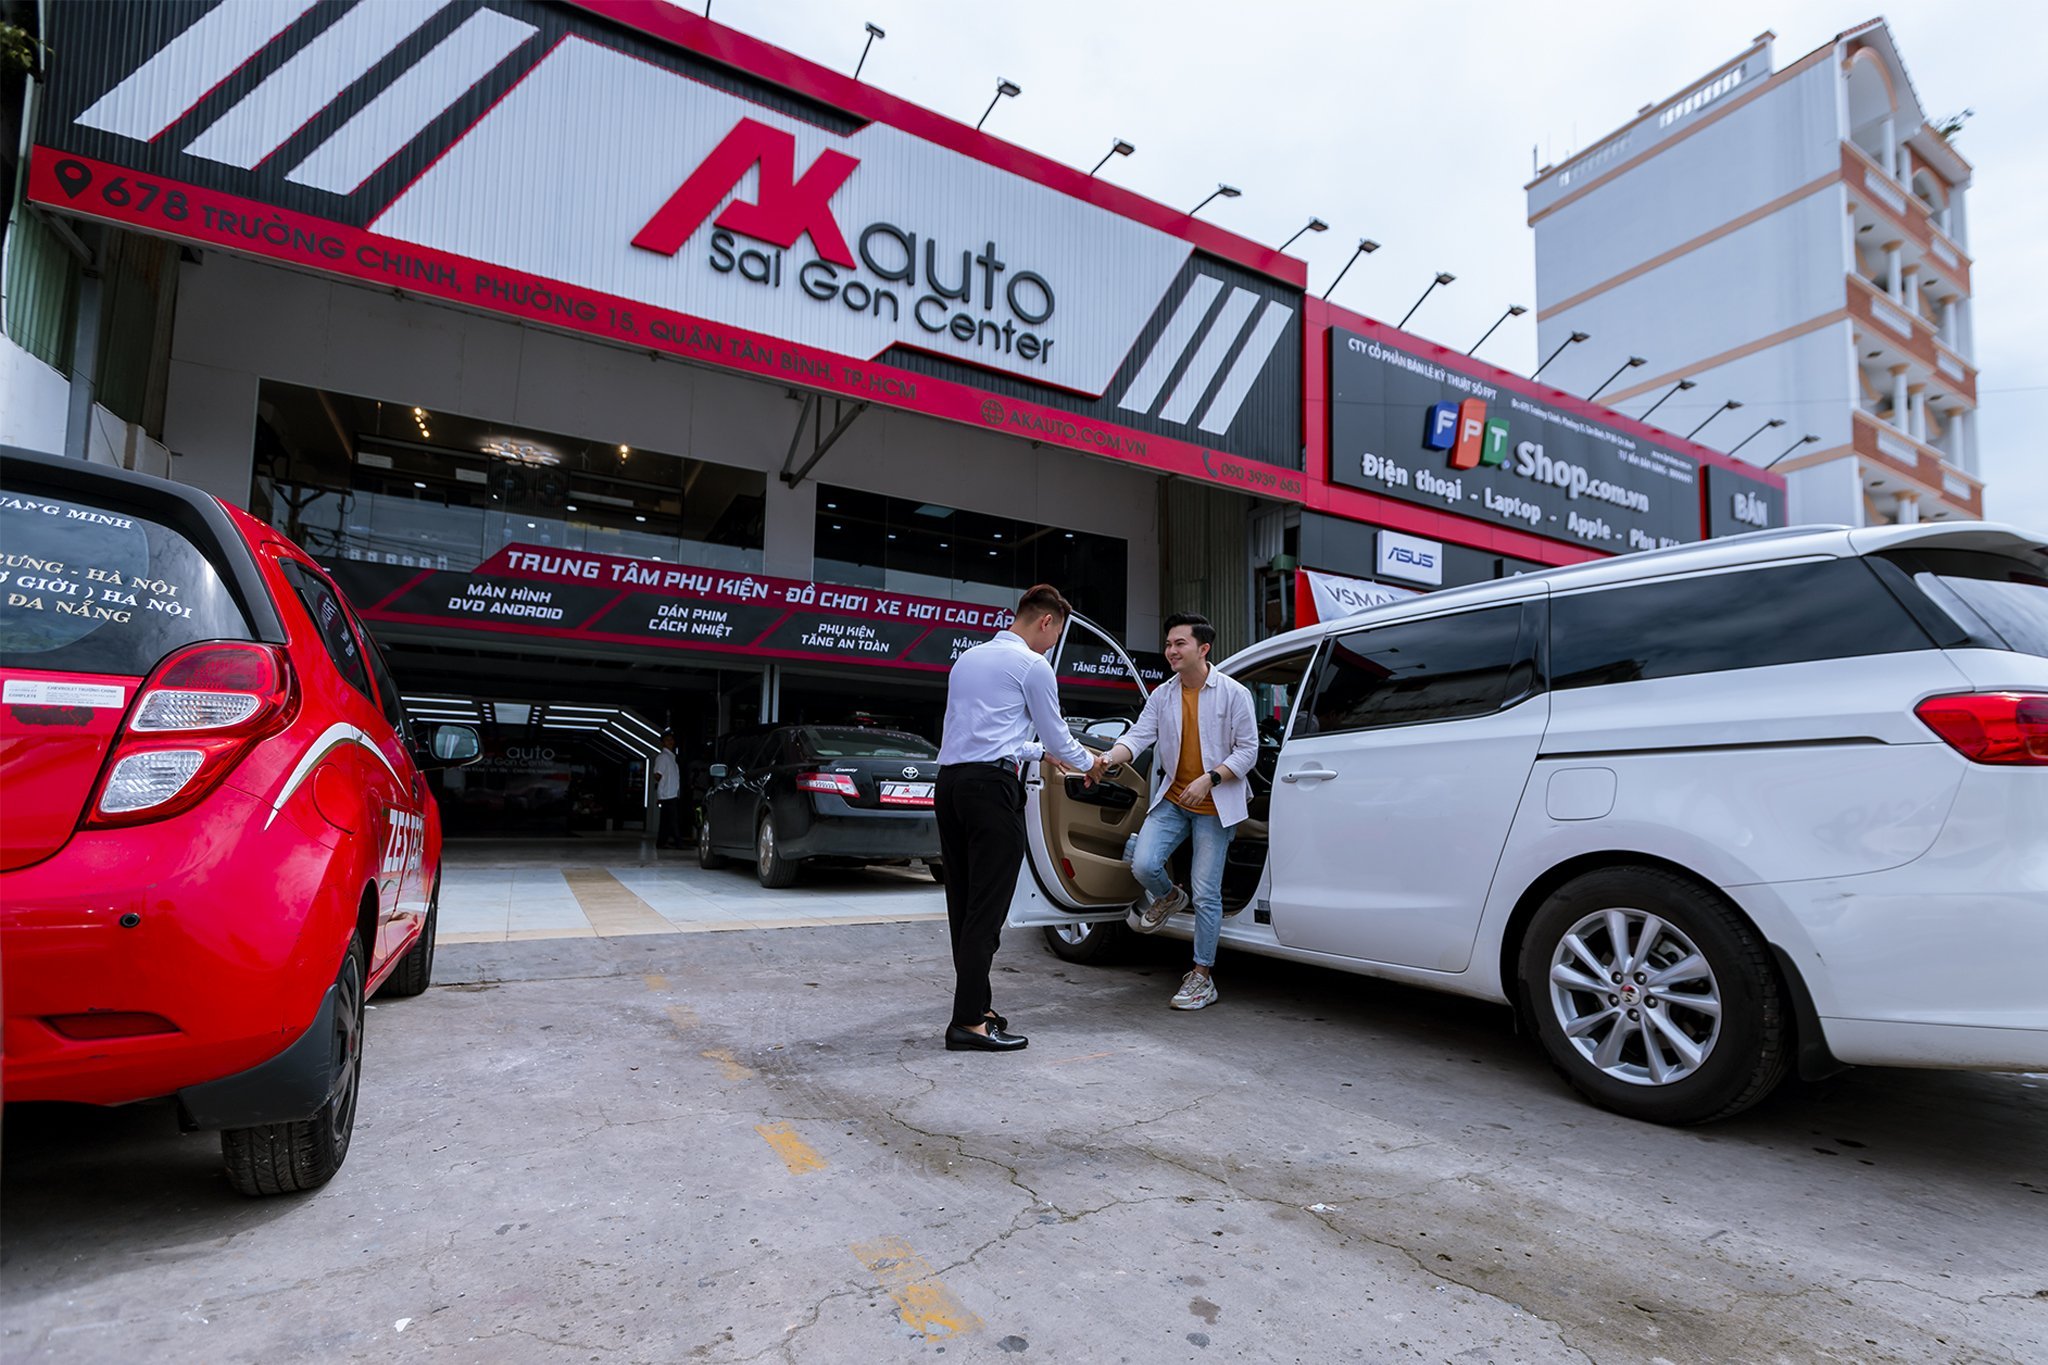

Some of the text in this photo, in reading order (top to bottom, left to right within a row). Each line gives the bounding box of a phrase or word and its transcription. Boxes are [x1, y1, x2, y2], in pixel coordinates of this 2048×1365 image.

[102, 176, 916, 400] 678 TRƯỜNG CHINH, PHƯỜNG 15, QUẬN TÂN BÌNH, TP.HCM
[709, 229, 1054, 363] Sai Gon Center
[1348, 338, 1367, 354] CTY
[1008, 410, 1147, 457] AKAUTO.COM.VN
[1436, 409, 1508, 453] FPT
[1221, 462, 1301, 494] 090 3939 683
[1362, 453, 1408, 488] Điện
[1414, 469, 1462, 503] thoại
[1484, 487, 1541, 525] Laptop
[1568, 511, 1611, 541] Apple
[1733, 491, 1768, 526] BÁN
[66, 509, 133, 530] MINH
[1388, 547, 1434, 568] ASUS
[86, 568, 123, 585] HÀ
[131, 576, 178, 597] NỘI
[467, 582, 552, 603] MÀN HÌNH
[507, 551, 601, 580] TRUNG
[611, 562, 660, 586] TÂM
[664, 571, 713, 596] PHỤ
[717, 577, 769, 601] KIỆN
[786, 582, 816, 605] ĐỒ
[819, 592, 868, 611] CHƠI
[874, 599, 902, 615] XE
[906, 603, 941, 620] HƠI
[944, 608, 979, 625] CAO
[982, 608, 1016, 629] CẤP
[16, 575, 79, 596] GIỜI
[146, 598, 192, 619] NỘI
[1325, 584, 1398, 607] VSMA
[448, 598, 563, 621] DVD ANDROID
[657, 604, 728, 623] DÁN PHIM
[648, 617, 733, 639] CÁCH NHIỆT
[818, 623, 875, 640] PHỤ KIỆN
[801, 632, 889, 653] TĂNG AN TOÀN
[1072, 661, 1096, 673] TĂNG
[1098, 664, 1123, 677] SÁNG
[1140, 668, 1163, 679] TOÀN
[1101, 652, 1115, 666] ĐỘ
[506, 745, 555, 760] auto
